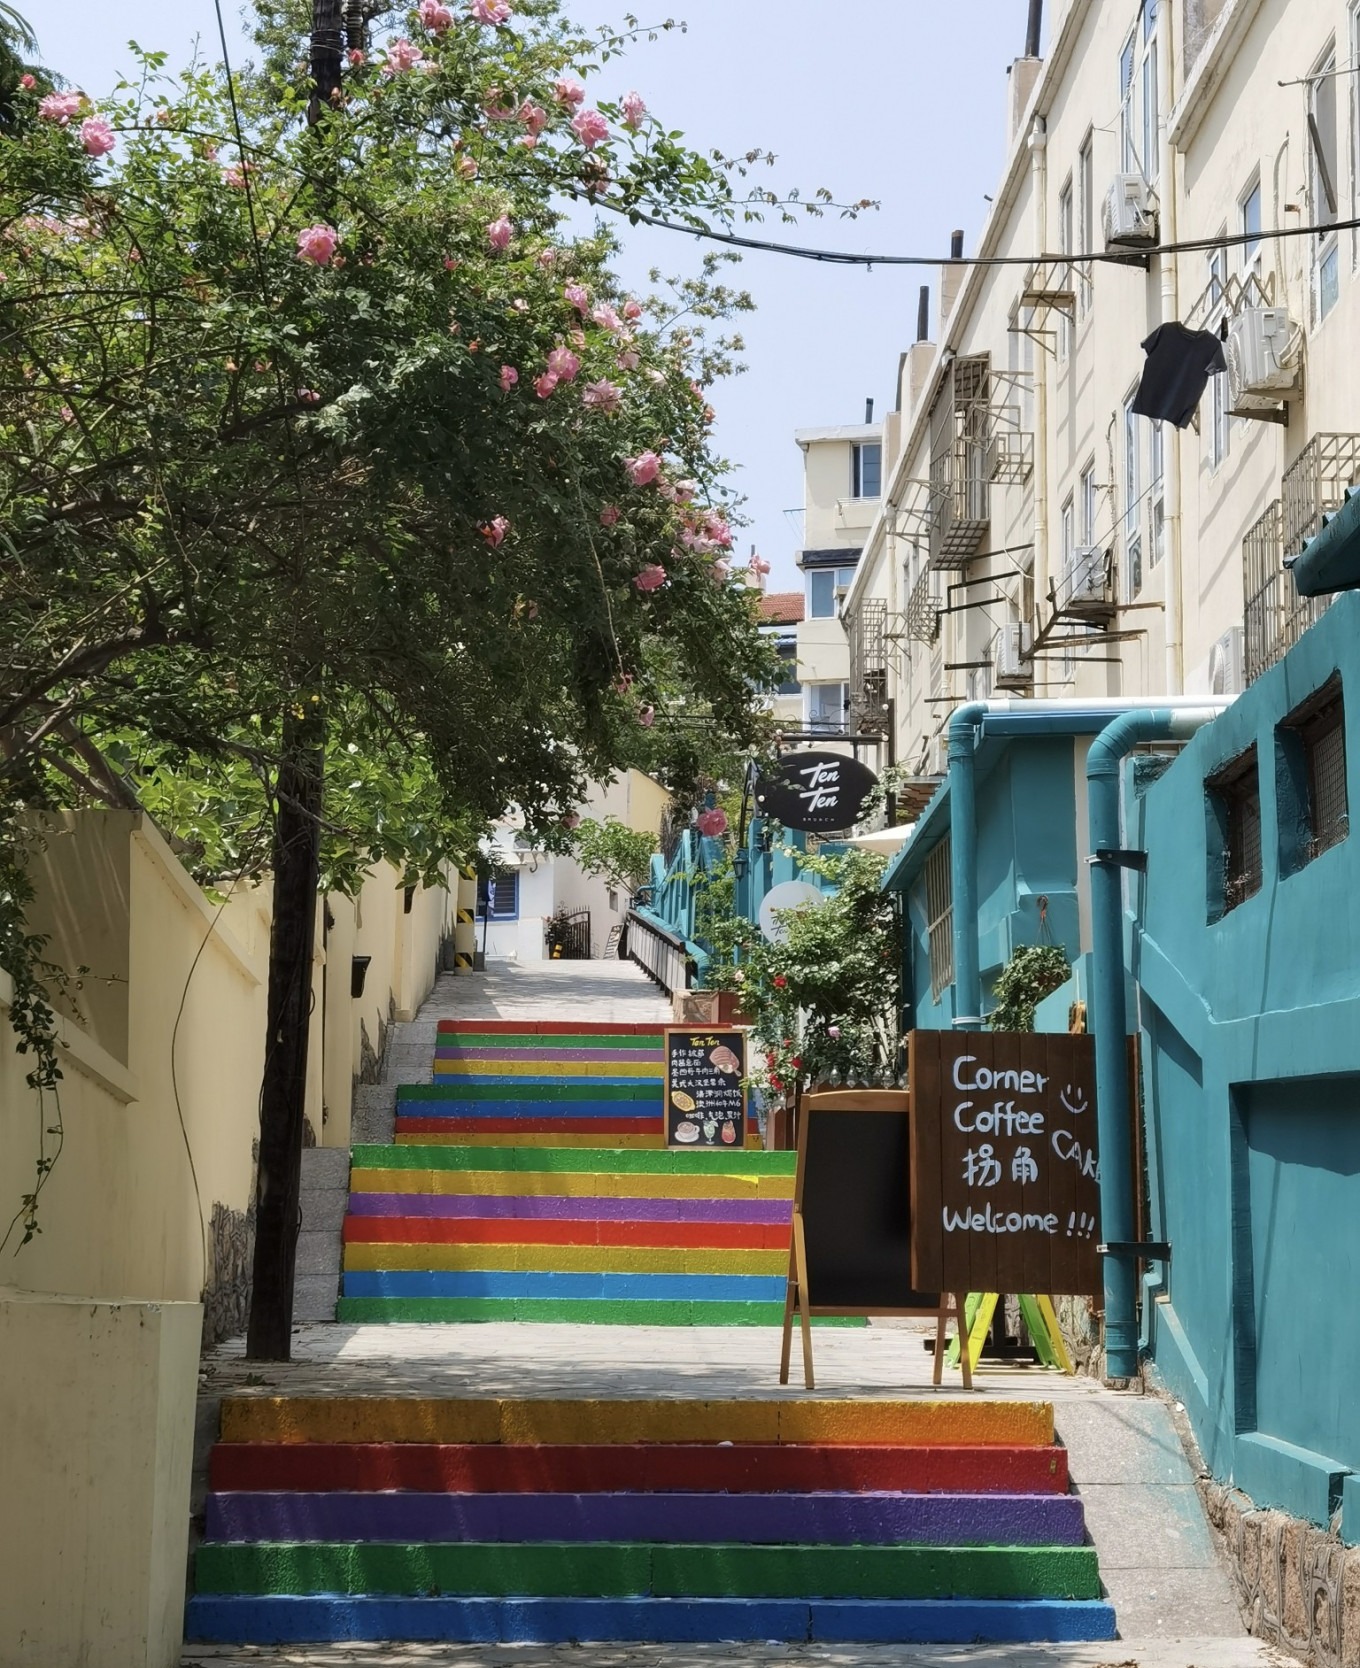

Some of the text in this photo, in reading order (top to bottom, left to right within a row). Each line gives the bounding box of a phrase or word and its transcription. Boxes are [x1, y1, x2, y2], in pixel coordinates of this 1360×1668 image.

[800, 761, 840, 788] Ten
[799, 786, 840, 812] Ten
[953, 1055, 1050, 1093] Corner
[954, 1100, 1045, 1136] Coffee
[942, 1201, 1059, 1234] Welcome
